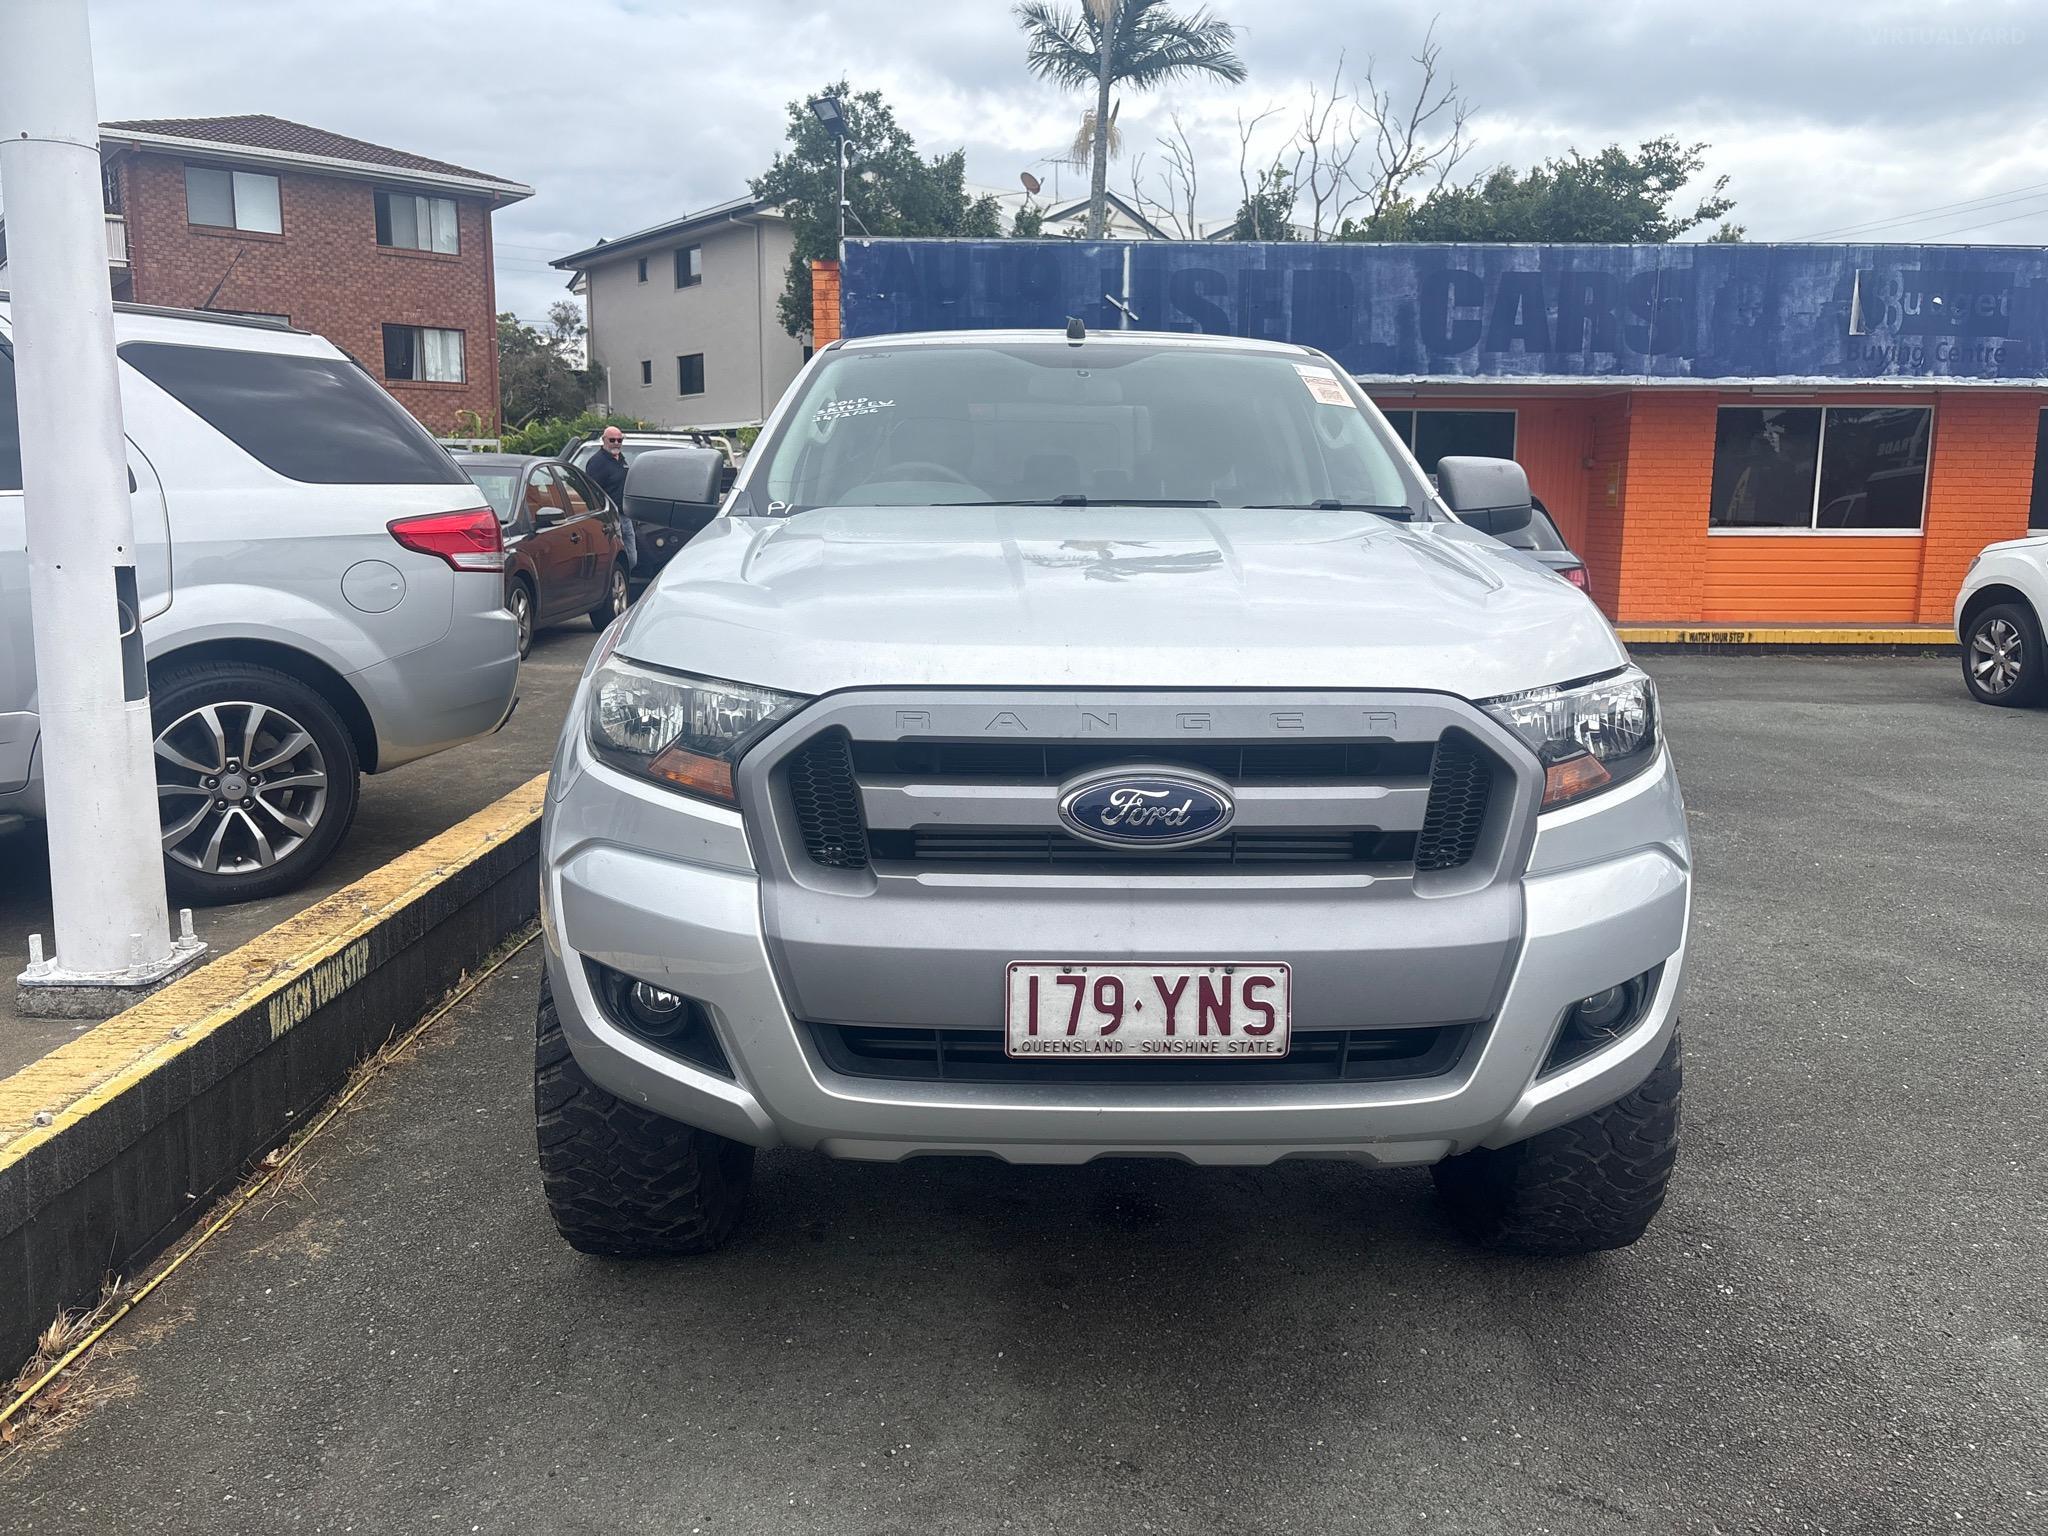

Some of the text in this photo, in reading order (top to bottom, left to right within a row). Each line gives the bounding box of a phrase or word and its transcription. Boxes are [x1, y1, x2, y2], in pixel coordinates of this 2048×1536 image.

[1420, 270, 1688, 354] CARS
[1847, 340, 2008, 371] Buying Centre
[1689, 631, 1745, 643] WATCH YOUR STEP
[895, 710, 1398, 732] RANGER
[1100, 788, 1193, 827] Ford
[311, 955, 346, 1009] YOUR
[1021, 1039, 1124, 1053] QUEENSLAND
[1141, 1039, 1219, 1053] SUNSHINE
[1227, 1039, 1276, 1053] STATE
